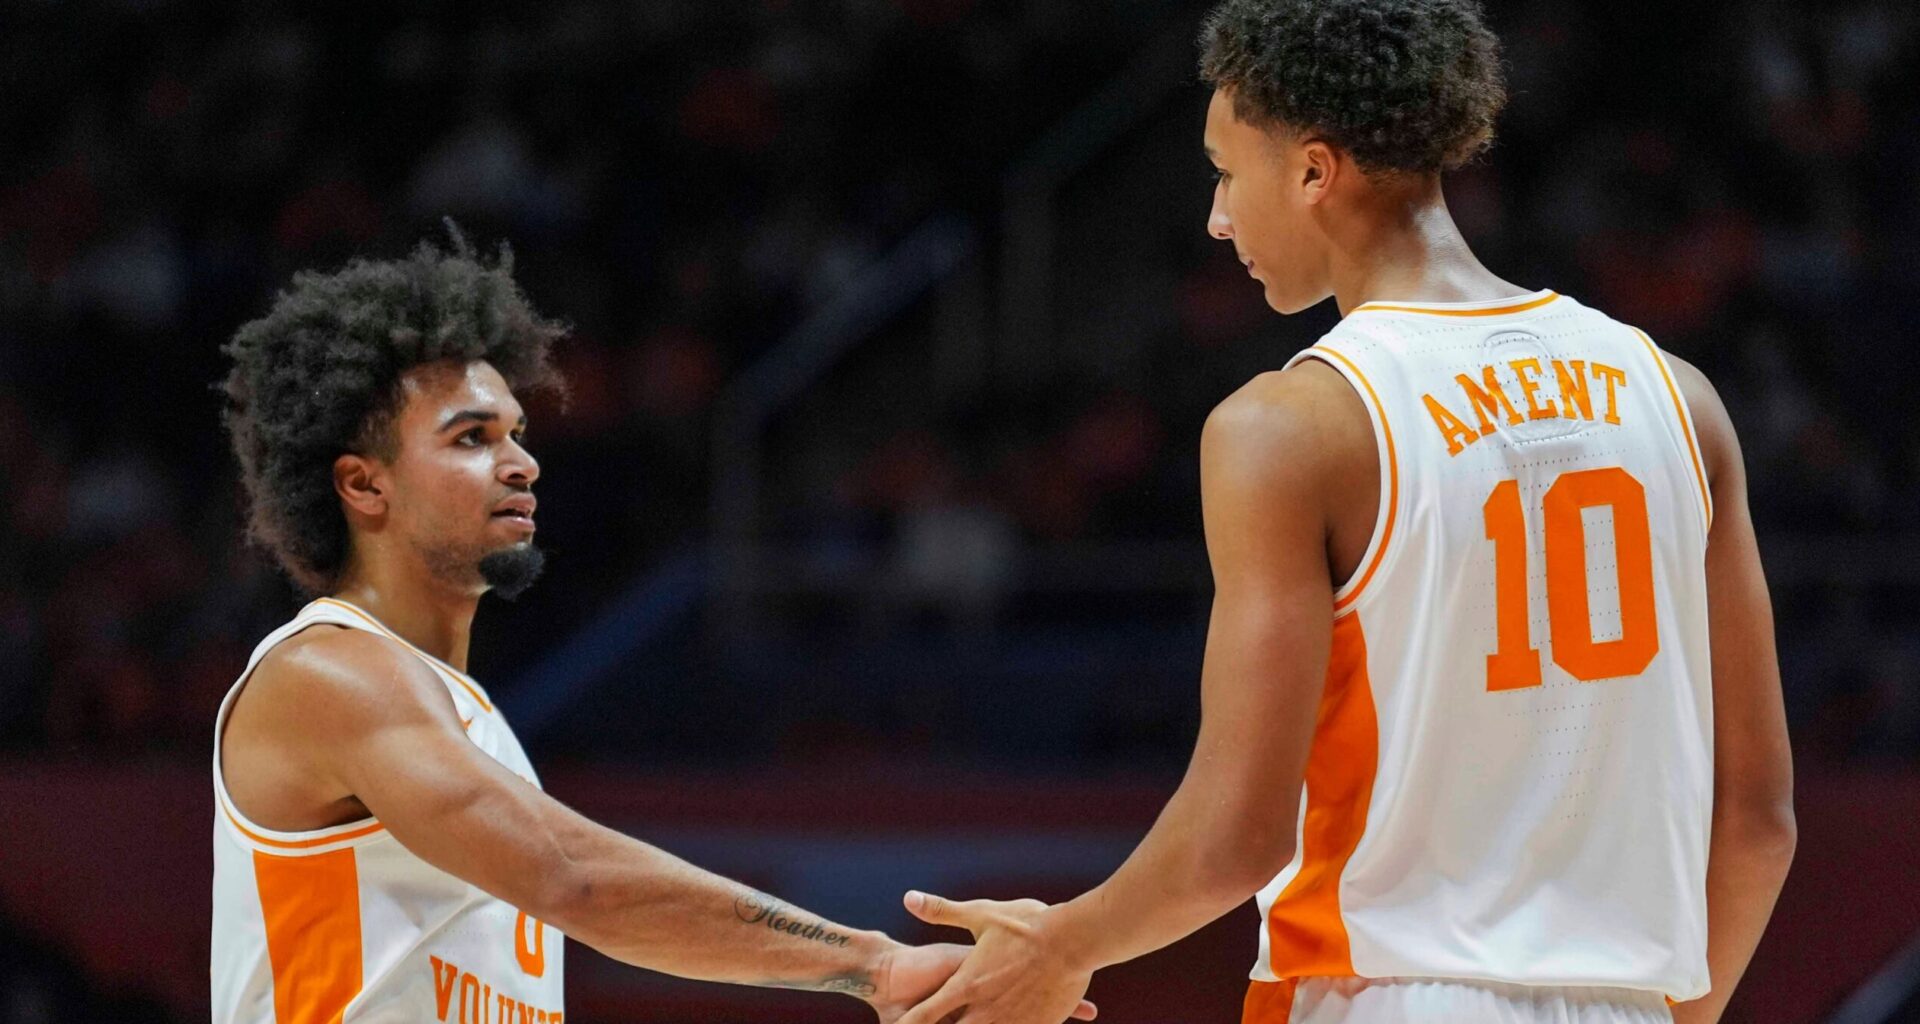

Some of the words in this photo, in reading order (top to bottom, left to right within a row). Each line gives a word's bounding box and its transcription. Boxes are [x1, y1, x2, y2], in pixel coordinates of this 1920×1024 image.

[1421, 357, 1627, 458] AMENT
[1482, 465, 1660, 692] 10
[734, 895, 850, 948] Heather
